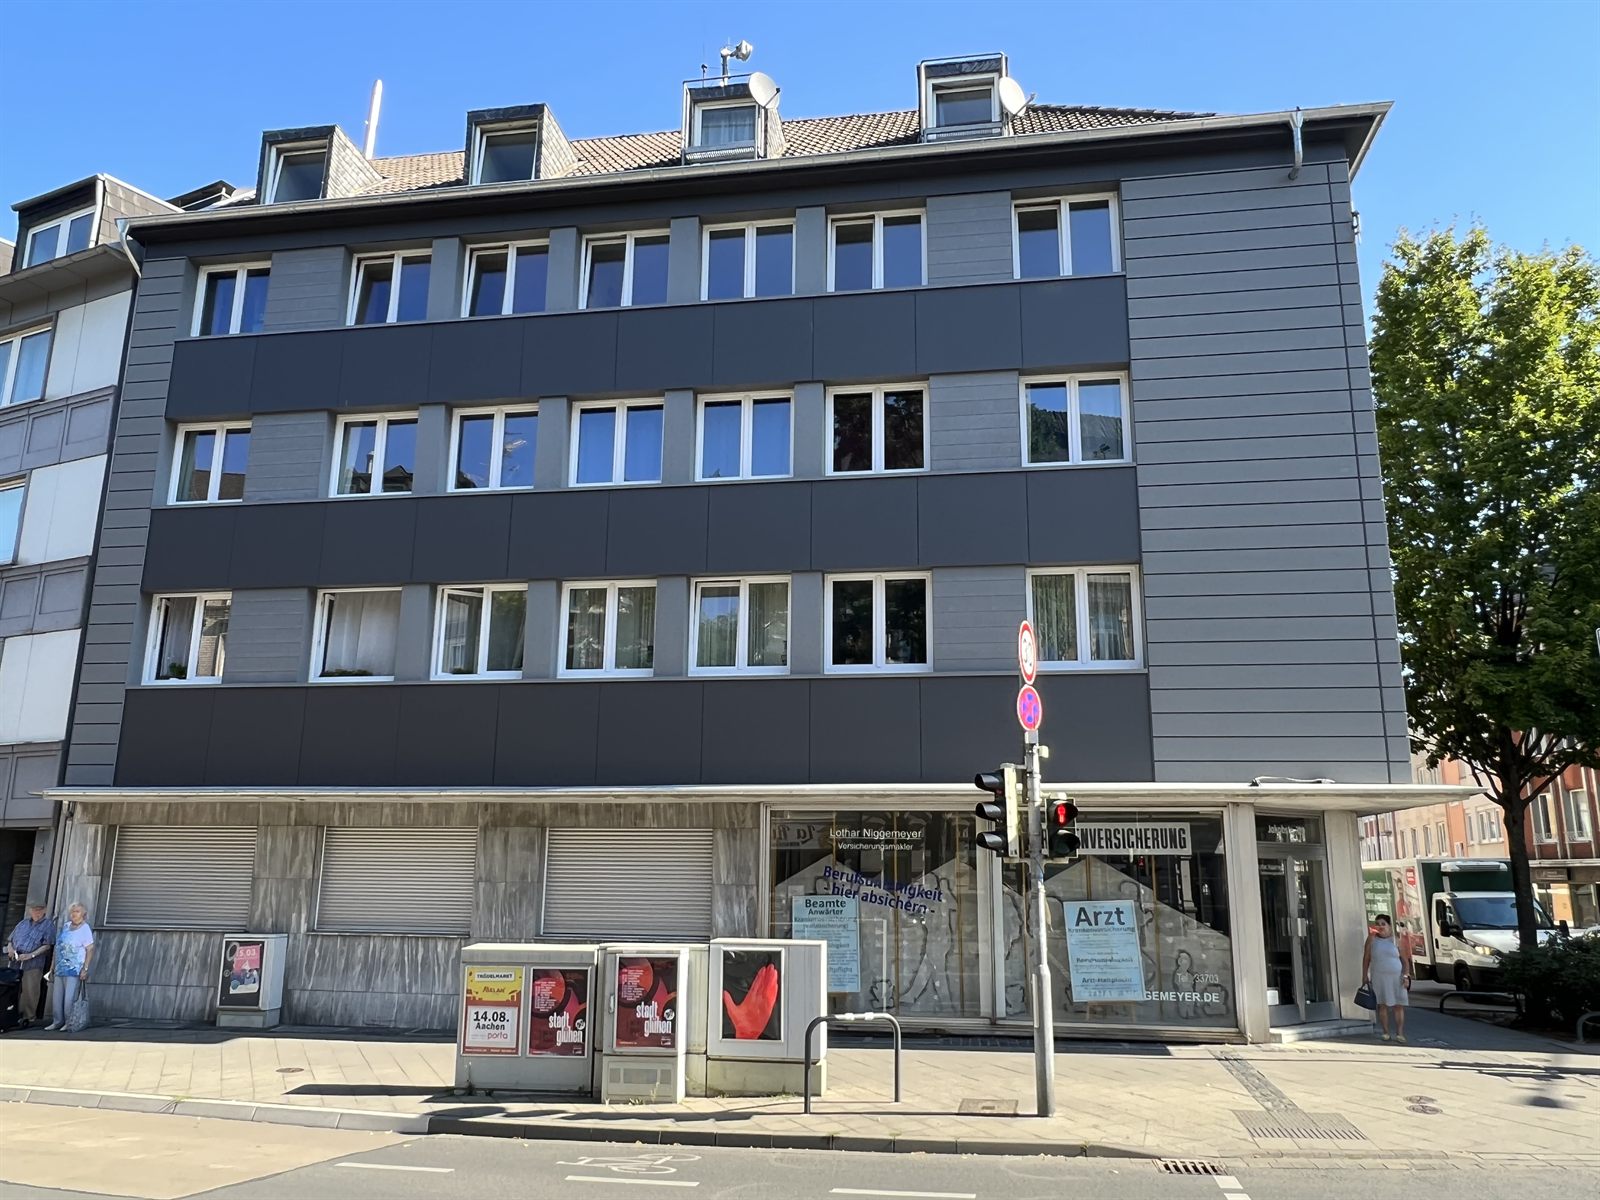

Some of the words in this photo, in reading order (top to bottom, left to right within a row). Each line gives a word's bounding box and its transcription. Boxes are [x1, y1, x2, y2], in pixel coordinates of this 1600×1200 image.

[830, 828, 860, 837] Lothar
[863, 828, 921, 840] Niggemeyer
[823, 866, 943, 902] Berufsunhigkeit
[805, 899, 846, 908] Beamte
[832, 883, 859, 899] hier
[861, 890, 927, 914] absichern
[1075, 907, 1125, 927] Arzt
[1194, 973, 1218, 983] 33703
[1144, 991, 1220, 1002] GEMEYER.DE
[636, 1000, 659, 1018] stadt
[473, 1010, 509, 1022] 14.08.
[548, 1011, 570, 1028] stadt
[487, 1032, 508, 1040] porta
